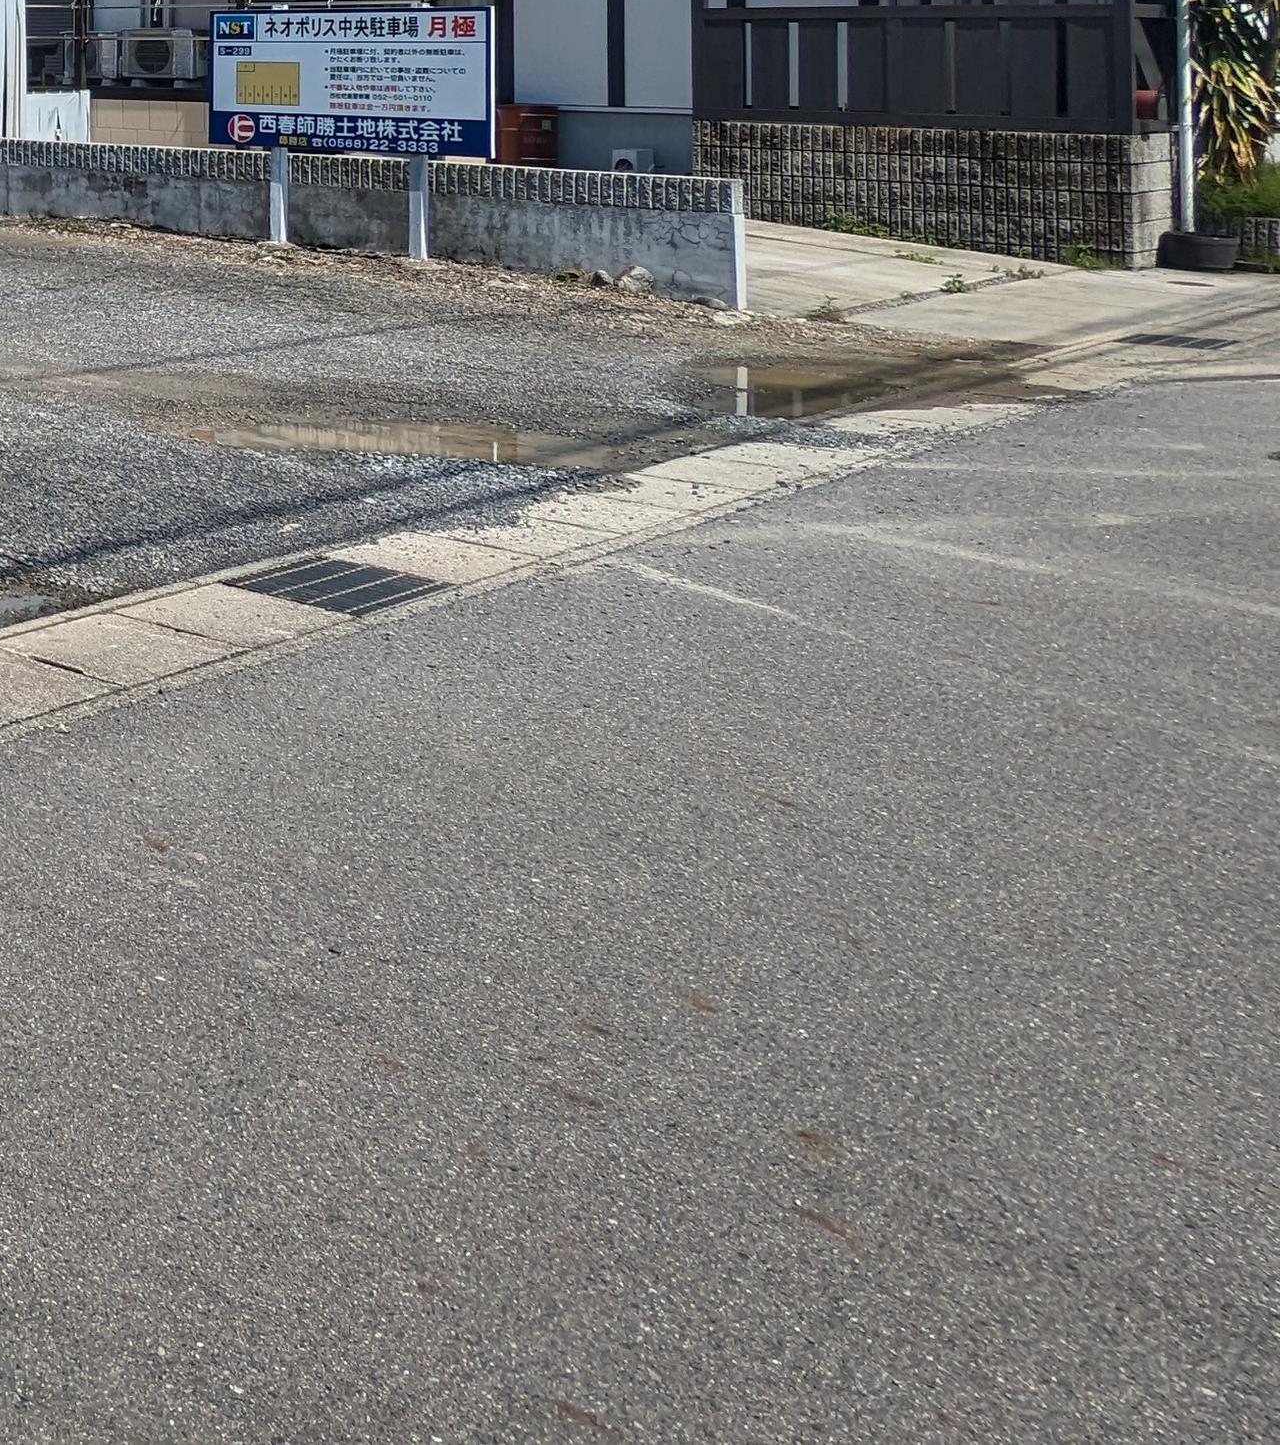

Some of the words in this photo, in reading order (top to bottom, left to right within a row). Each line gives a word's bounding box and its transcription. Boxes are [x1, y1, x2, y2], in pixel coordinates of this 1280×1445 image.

[219, 21, 251, 35] NST
[264, 16, 420, 38] ネオポリス中央駐車場
[427, 16, 476, 38] 月極
[259, 114, 464, 142] 西春師勝土地株式会社
